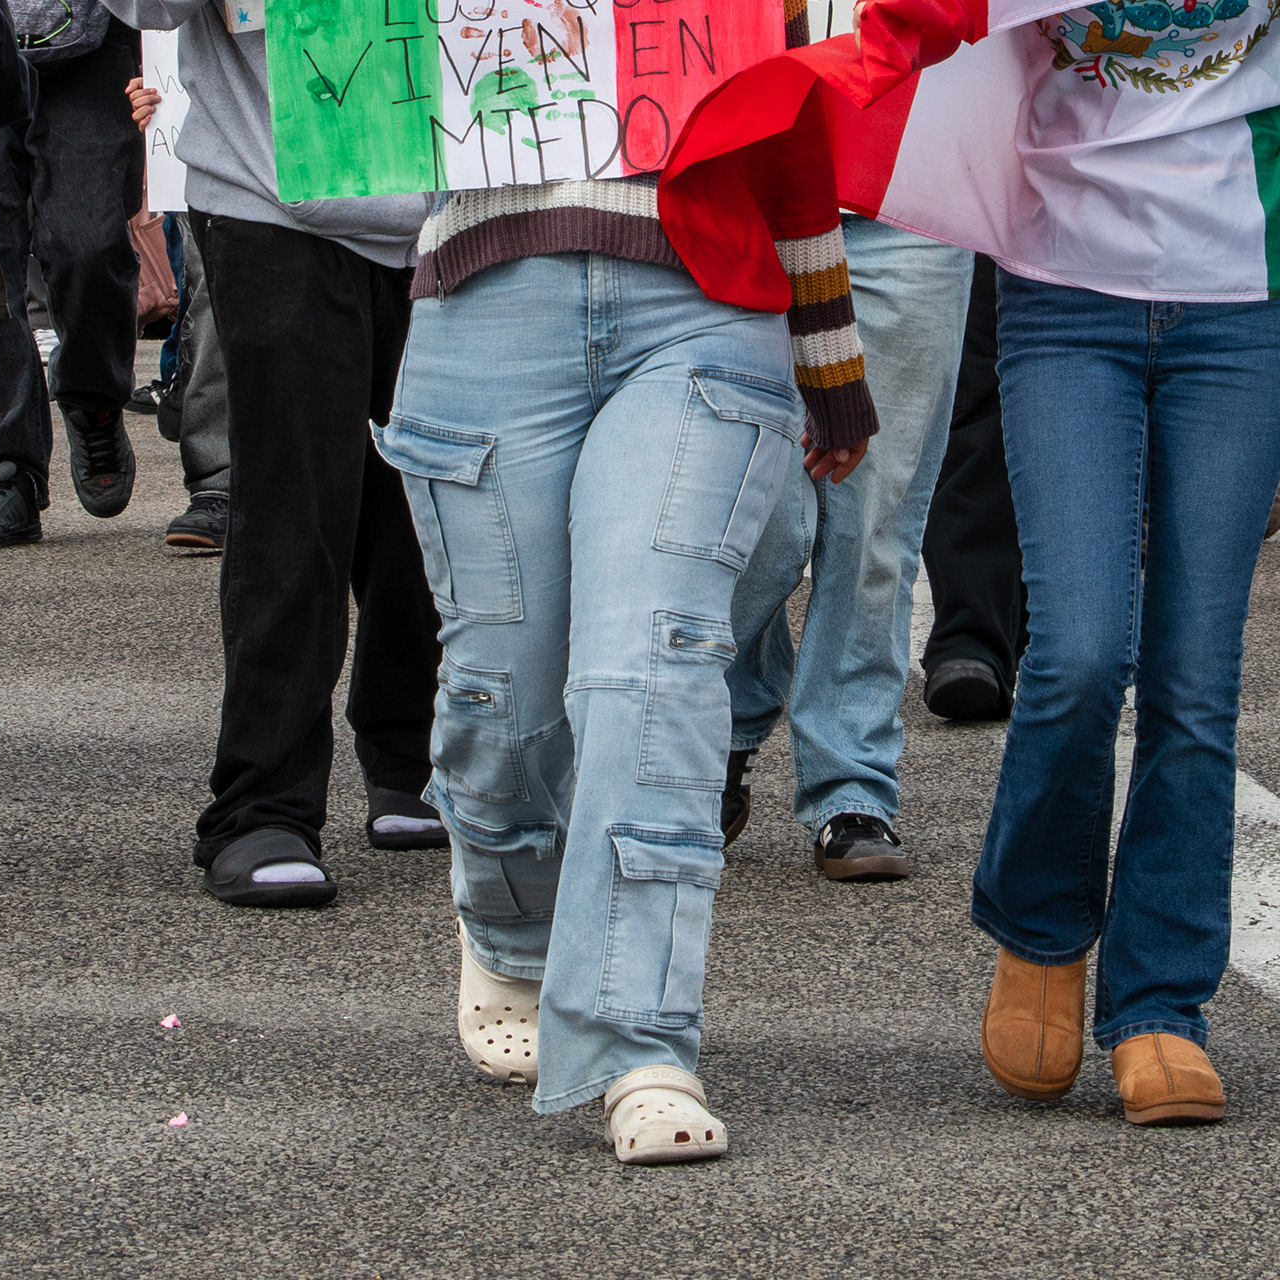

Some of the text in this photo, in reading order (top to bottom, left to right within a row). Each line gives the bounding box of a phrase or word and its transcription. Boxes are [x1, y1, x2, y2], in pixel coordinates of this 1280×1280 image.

[302, 17, 589, 108] VIVEN
[631, 17, 718, 80] EN
[429, 93, 672, 191] MIEDO
